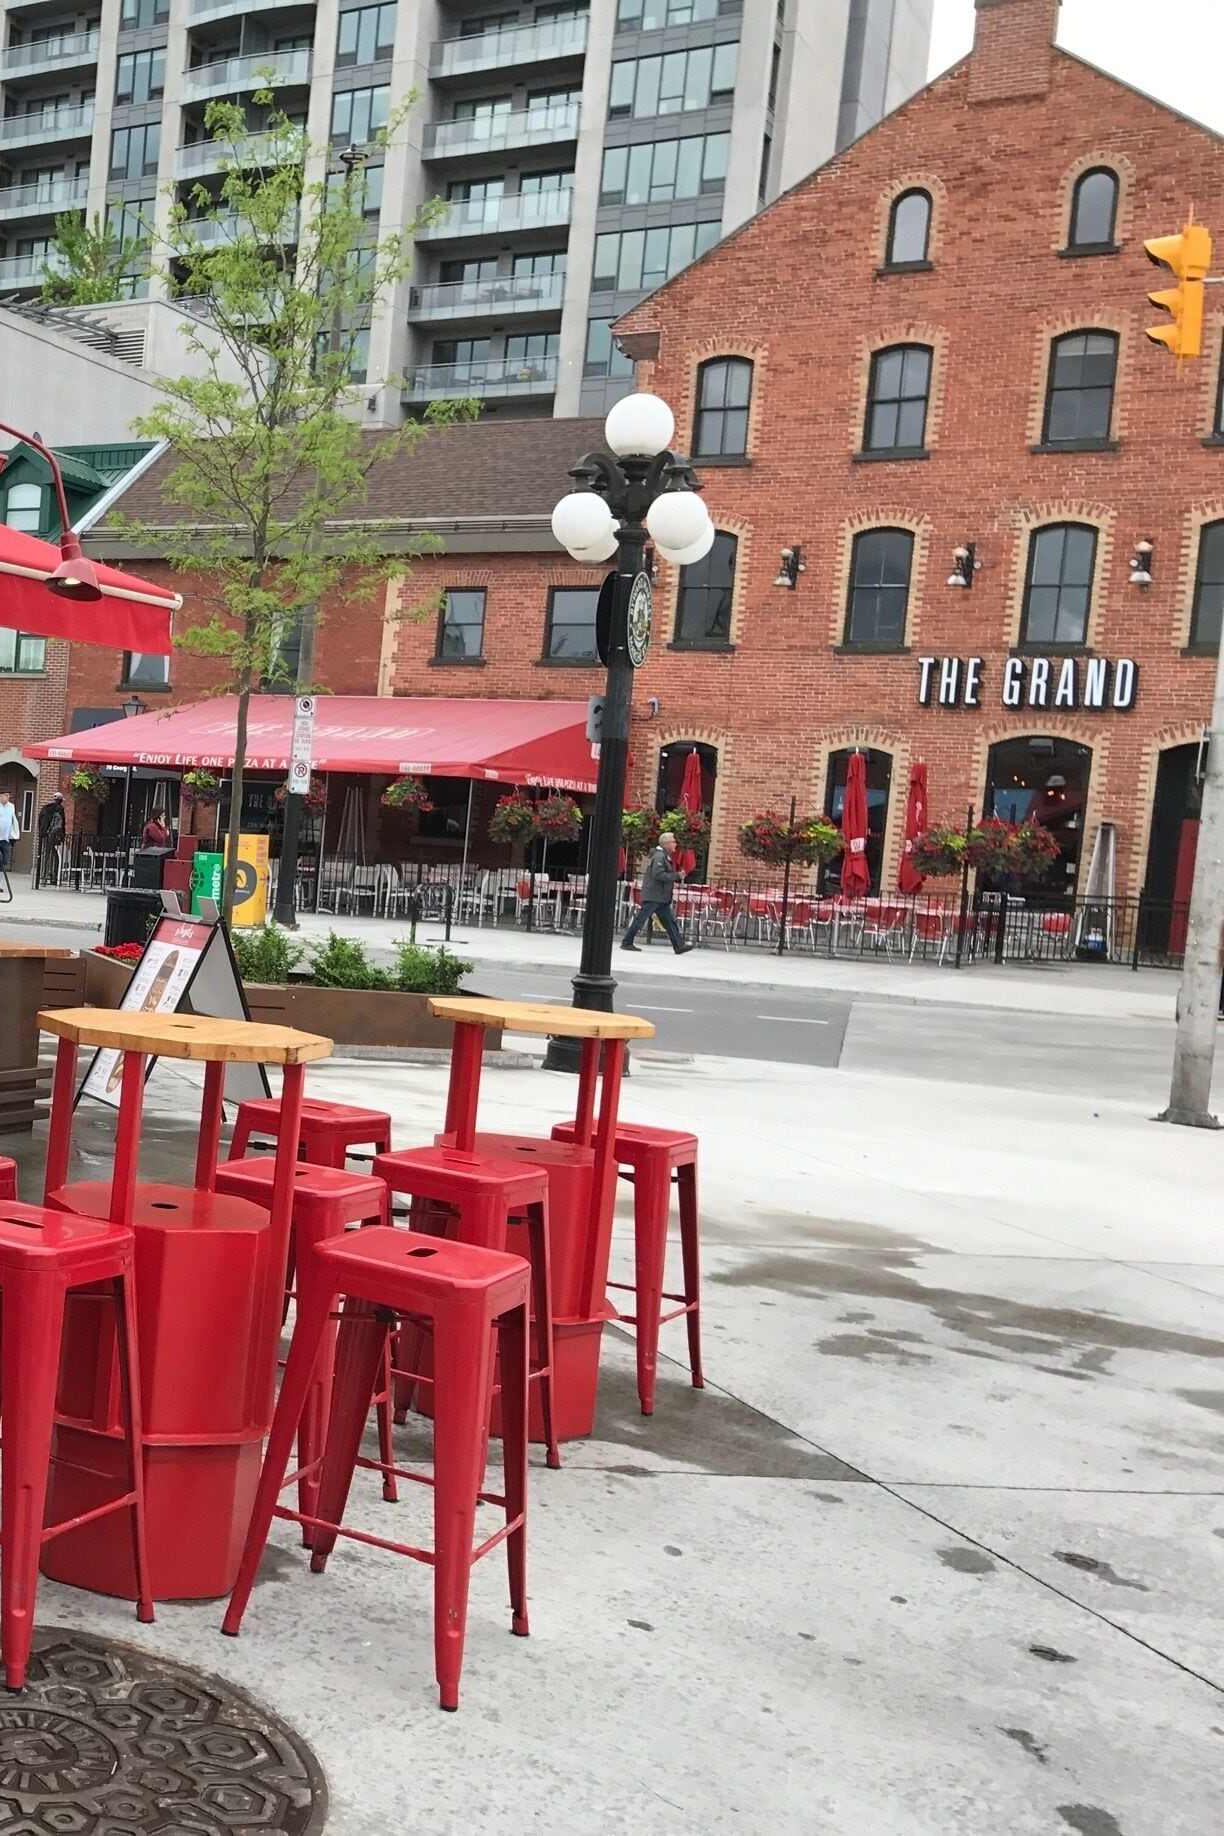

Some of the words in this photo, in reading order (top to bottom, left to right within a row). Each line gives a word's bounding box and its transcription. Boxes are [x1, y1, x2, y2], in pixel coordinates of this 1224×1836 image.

[918, 657, 982, 704] THE
[1002, 657, 1135, 707] GRAND
[175, 753, 197, 766] LIFE
[201, 756, 223, 766] ONE
[228, 757, 258, 769] PZA
[261, 758, 275, 769] AT
[278, 759, 287, 769] A
